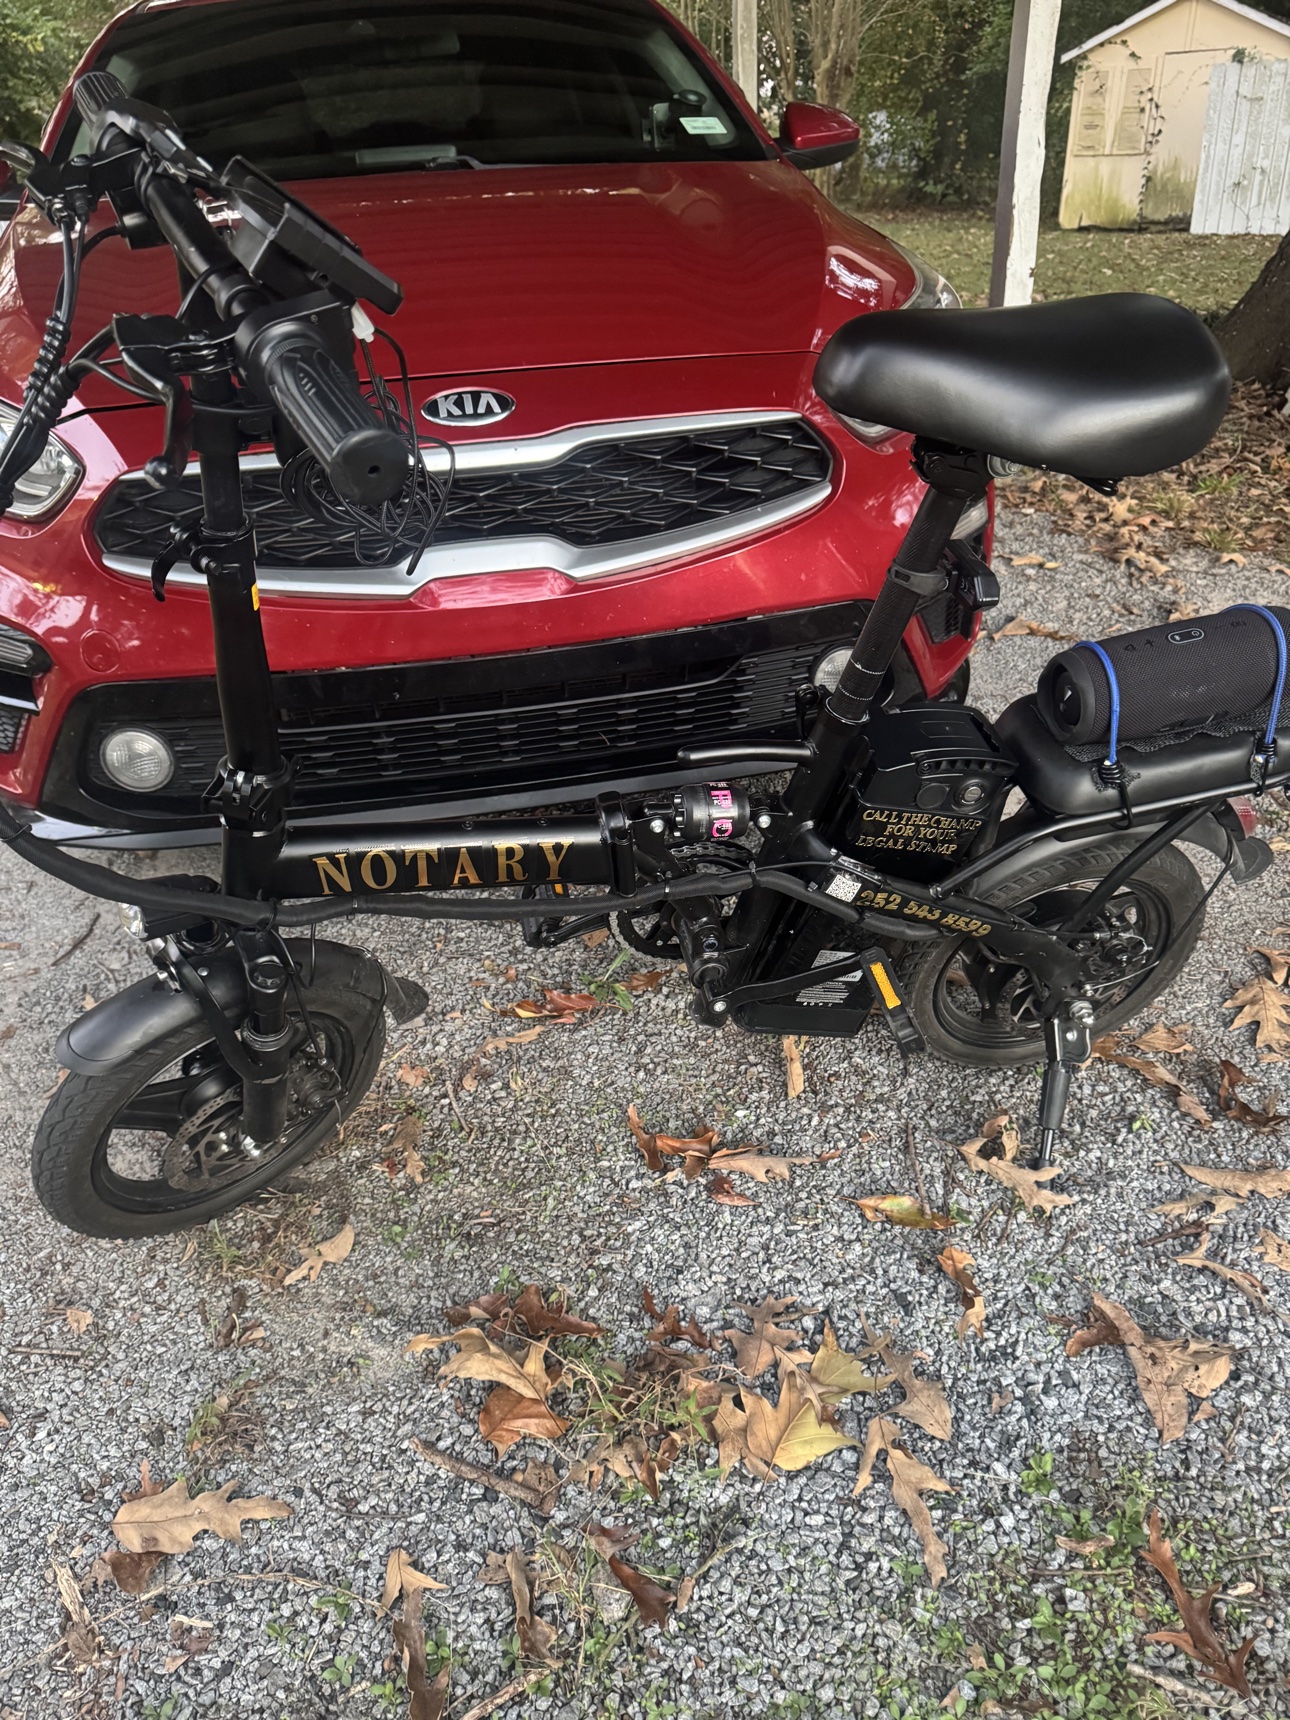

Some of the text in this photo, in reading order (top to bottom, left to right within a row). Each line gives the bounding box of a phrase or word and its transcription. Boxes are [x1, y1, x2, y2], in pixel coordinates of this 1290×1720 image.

[437, 392, 502, 418] KIA
[862, 809, 900, 823] CALL
[883, 824, 957, 840] FOR YOUR
[855, 835, 958, 855] LEGAL STAMP
[311, 838, 576, 896] NOTARY
[856, 890, 902, 910] 252
[939, 913, 992, 937] 8599
